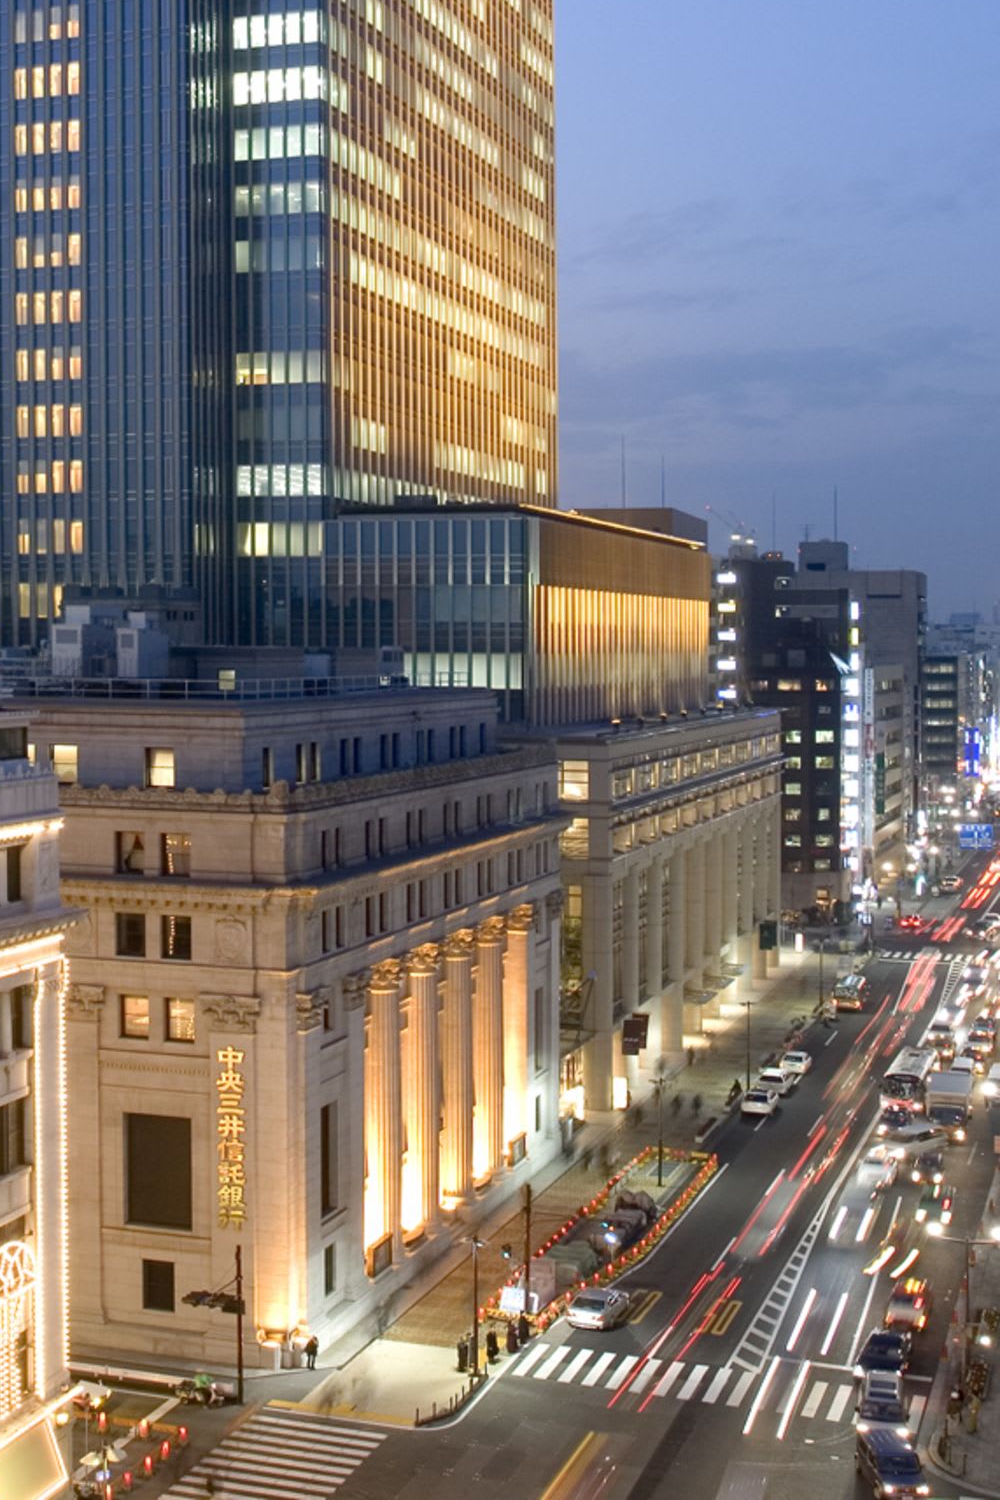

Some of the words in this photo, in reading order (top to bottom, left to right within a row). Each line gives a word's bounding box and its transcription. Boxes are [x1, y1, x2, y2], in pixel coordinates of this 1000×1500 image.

[216, 1045, 247, 1232] 中央三井信託銀行
